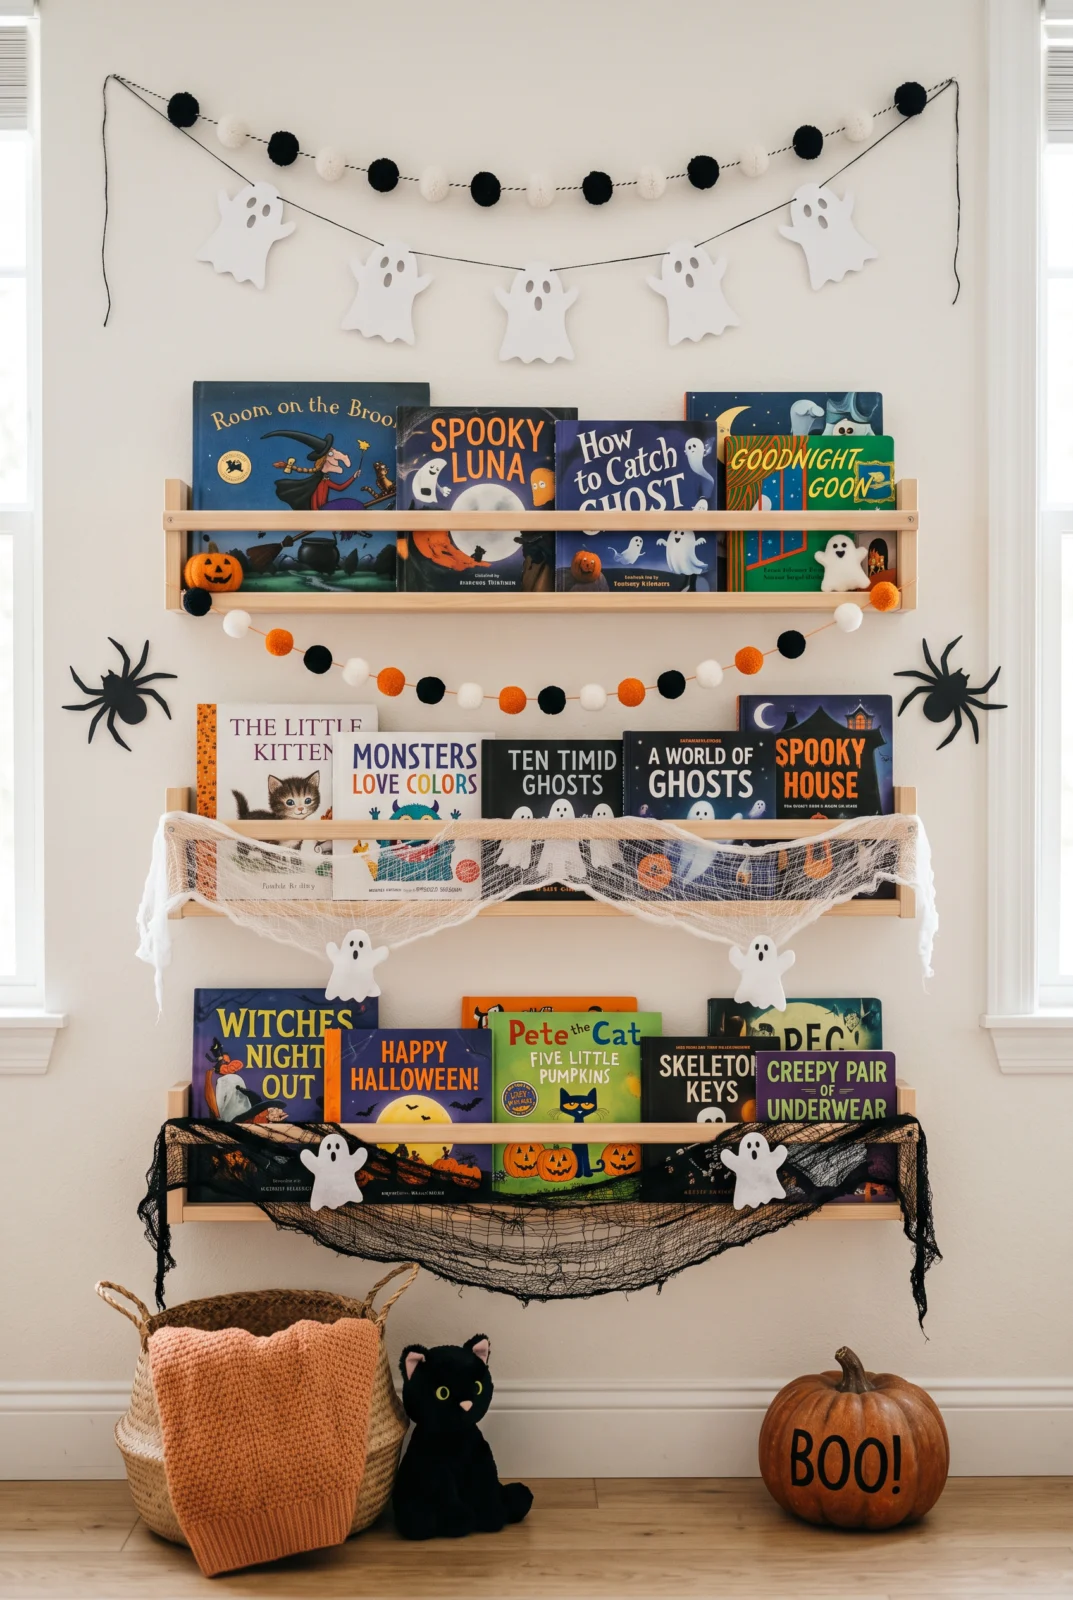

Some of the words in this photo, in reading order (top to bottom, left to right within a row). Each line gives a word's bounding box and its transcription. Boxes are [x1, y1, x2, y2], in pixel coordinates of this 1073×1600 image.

[211, 404, 272, 431] Room
[278, 400, 304, 414] on
[309, 396, 340, 415] the
[431, 417, 545, 453] SPOOKY
[576, 429, 634, 464] How
[452, 450, 526, 484] LUNA
[574, 469, 602, 494] to
[606, 437, 678, 486] Catch
[730, 448, 864, 471] GOODNIGHT
[808, 474, 874, 498] GOON
[230, 718, 276, 736] THE
[353, 743, 478, 770] MONSTERS
[508, 750, 549, 771] TEN
[557, 750, 617, 771] TIMID
[648, 748, 660, 765] A
[666, 747, 726, 765] WORLD
[732, 747, 754, 765] OF
[776, 738, 866, 769] SPOOKY
[353, 774, 399, 794] LOVE
[406, 774, 478, 794] COLORS
[522, 774, 603, 796] GHOSTS
[648, 769, 754, 799] GHOSTS
[784, 771, 858, 801] HOUSE
[216, 1008, 354, 1038] WITCHES
[509, 1019, 569, 1046] Pete
[570, 1023, 591, 1036] the
[592, 1021, 641, 1046] Cat
[246, 1044, 325, 1069] NIGHT
[381, 1040, 448, 1064] HAPPY
[530, 1051, 563, 1068] FIVE
[569, 1050, 620, 1066] LITTLE
[351, 1066, 479, 1092] HALLOWEEN!
[539, 1068, 610, 1084] PUMPKINS
[767, 1060, 838, 1084] CREEPY
[846, 1060, 887, 1083] PAIR
[262, 1074, 316, 1100] OUT
[686, 1080, 740, 1104] KEYS
[820, 1084, 836, 1096] OF
[767, 1098, 887, 1121] UNDERWEAR
[790, 1428, 902, 1495] BOO!
